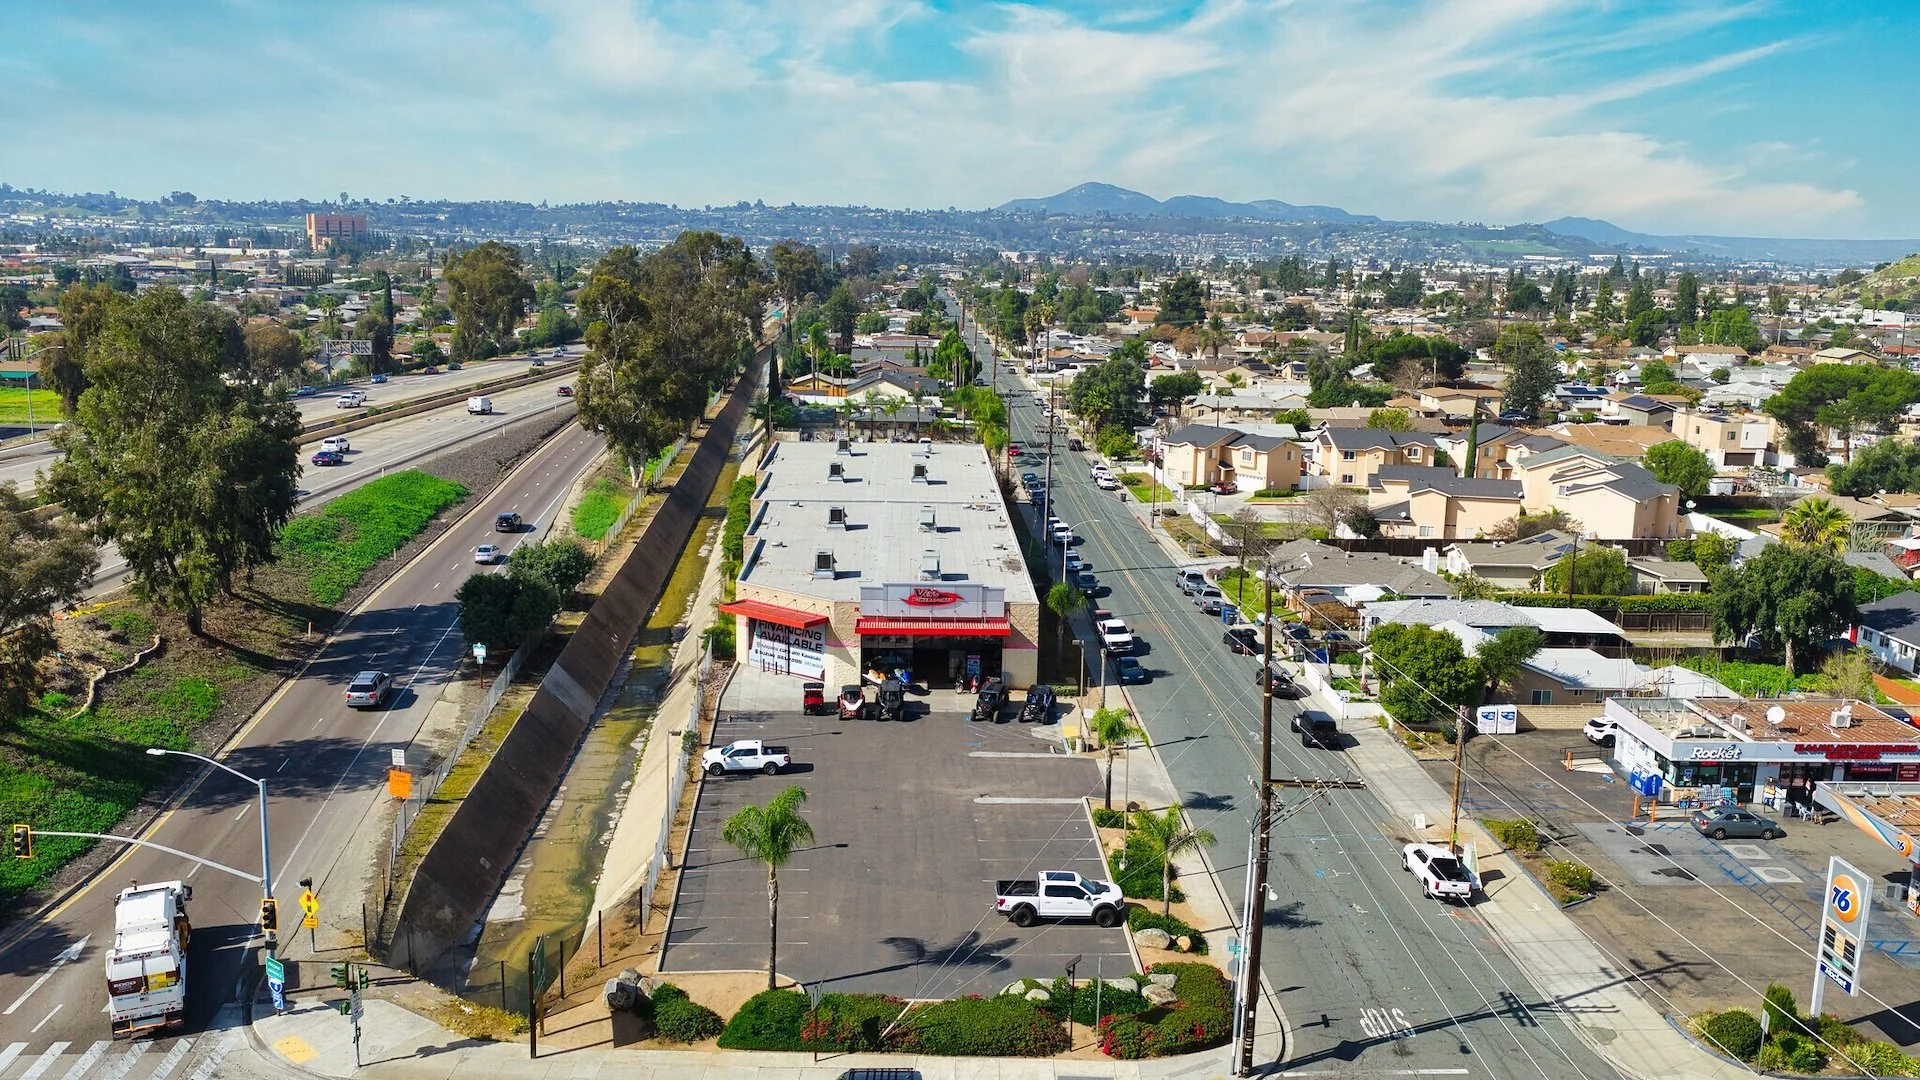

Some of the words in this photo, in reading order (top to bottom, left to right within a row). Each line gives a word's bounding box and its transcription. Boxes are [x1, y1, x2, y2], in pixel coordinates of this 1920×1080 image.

[759, 620, 822, 641] FINANCING
[759, 631, 823, 653] AVAILABLE
[1691, 747, 1741, 759] Rocket
[1897, 840, 1905, 851] 76
[1831, 886, 1850, 912] 76
[1825, 966, 1847, 989] Rocket
[1360, 1008, 1416, 1037] STOP
